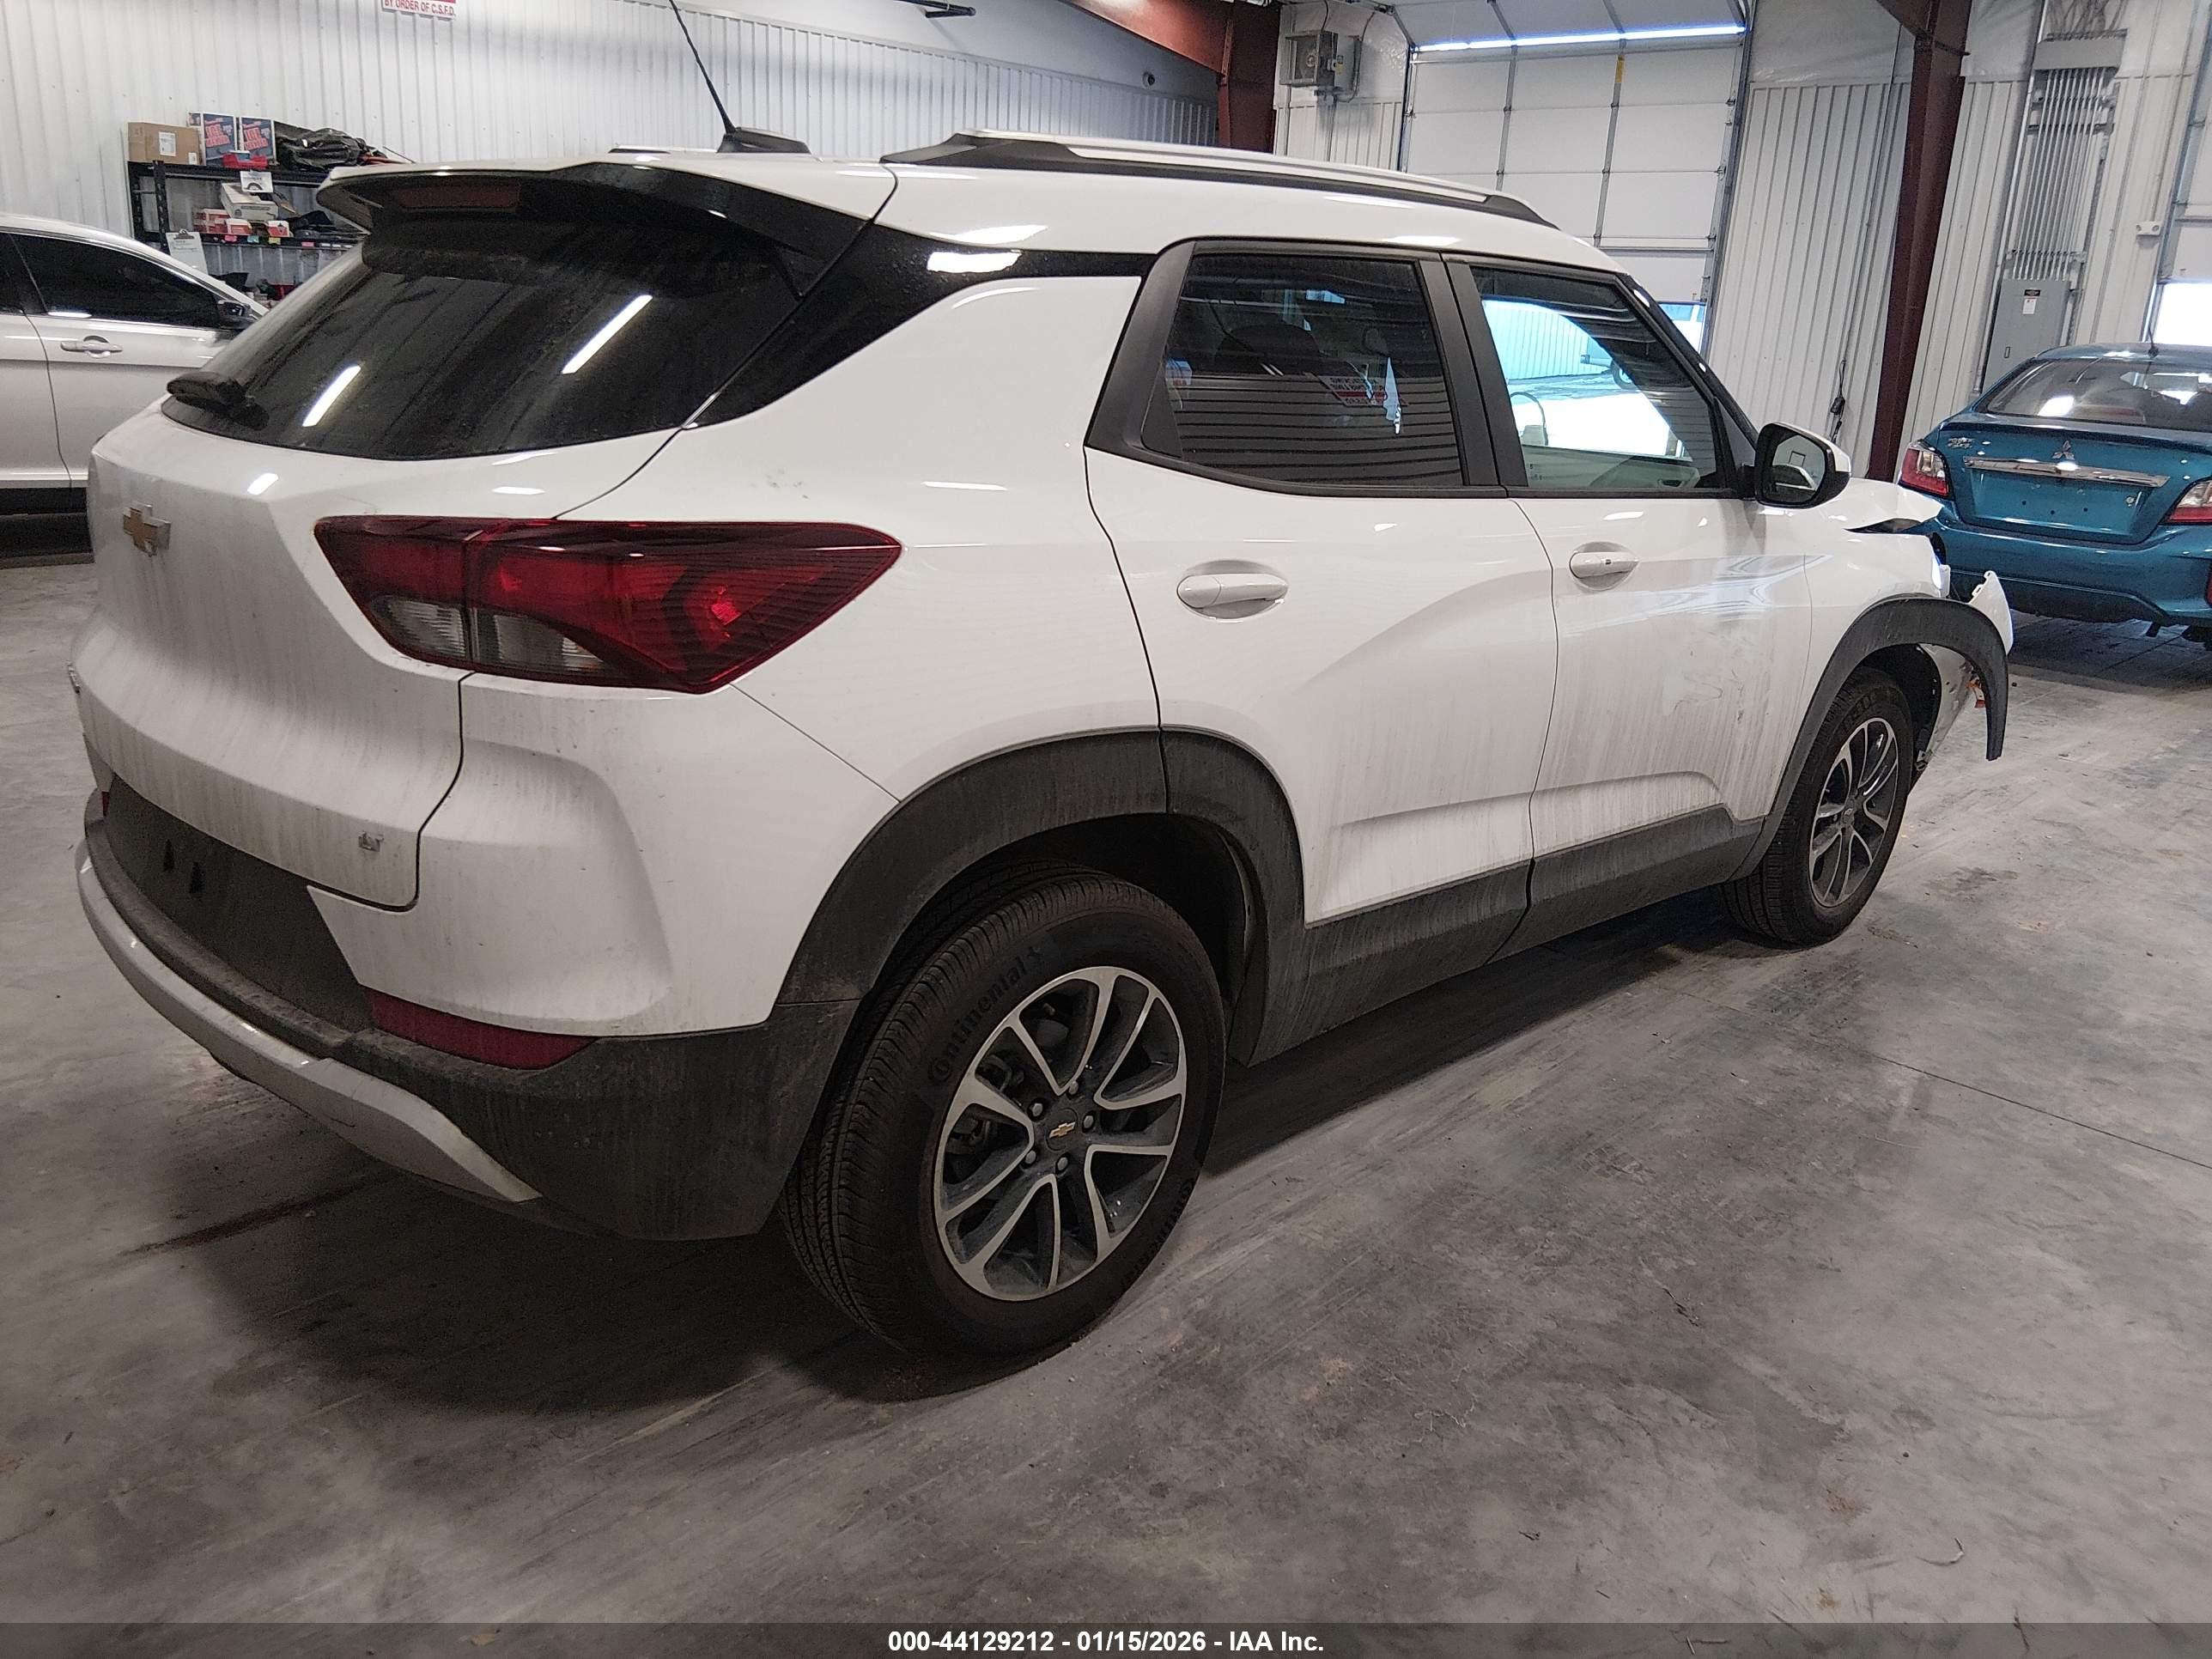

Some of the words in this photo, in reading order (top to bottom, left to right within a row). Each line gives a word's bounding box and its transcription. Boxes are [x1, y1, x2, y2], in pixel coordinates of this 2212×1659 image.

[396, 0, 419, 11] ORDER
[420, 3, 430, 12] OF
[927, 956, 1026, 1081] Continental
